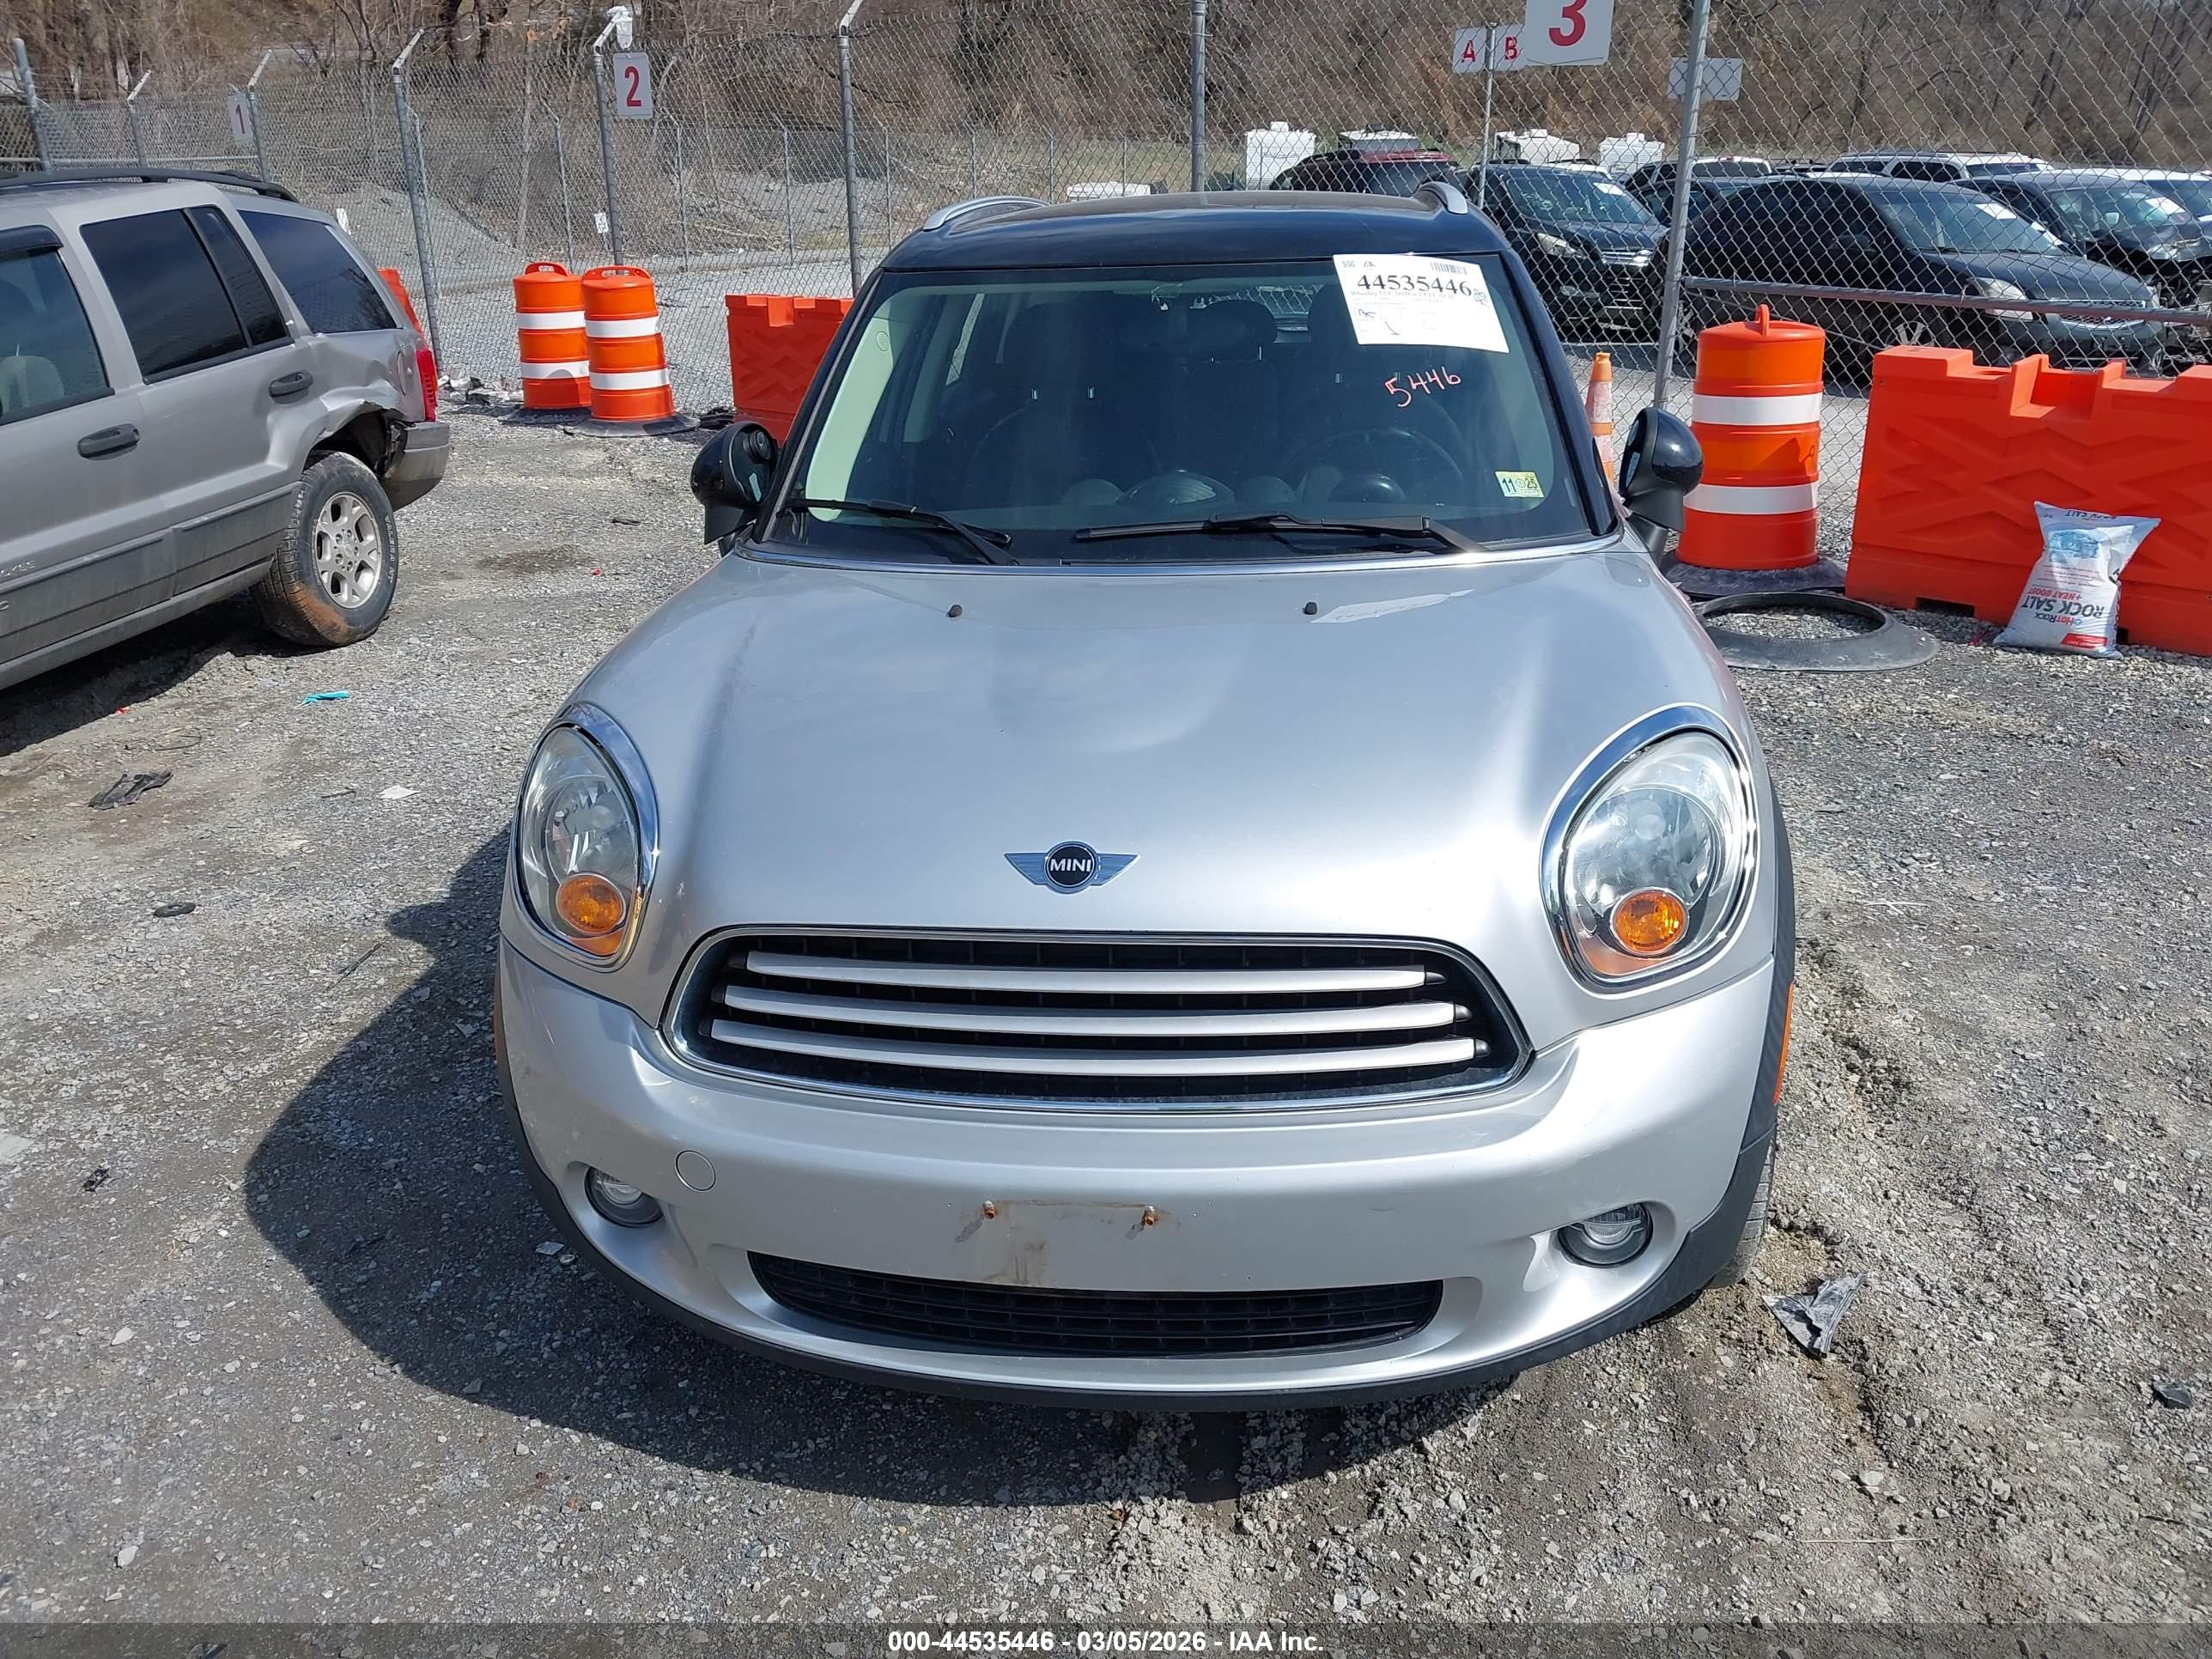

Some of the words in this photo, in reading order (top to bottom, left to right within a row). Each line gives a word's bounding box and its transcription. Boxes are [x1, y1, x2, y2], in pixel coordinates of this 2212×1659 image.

[1548, 0, 1588, 47] 3
[1462, 40, 1476, 63] A
[1504, 36, 1517, 60] B
[624, 65, 642, 107] 2
[235, 104, 245, 134] 1
[1357, 273, 1472, 297] 44535446
[1384, 366, 1462, 408] 5446
[1502, 477, 1517, 493] 11
[2021, 594, 2057, 613] SALT
[2027, 587, 2052, 598] BOOST
[2059, 601, 2105, 618] ROCK
[1050, 859, 1091, 872] MINI
